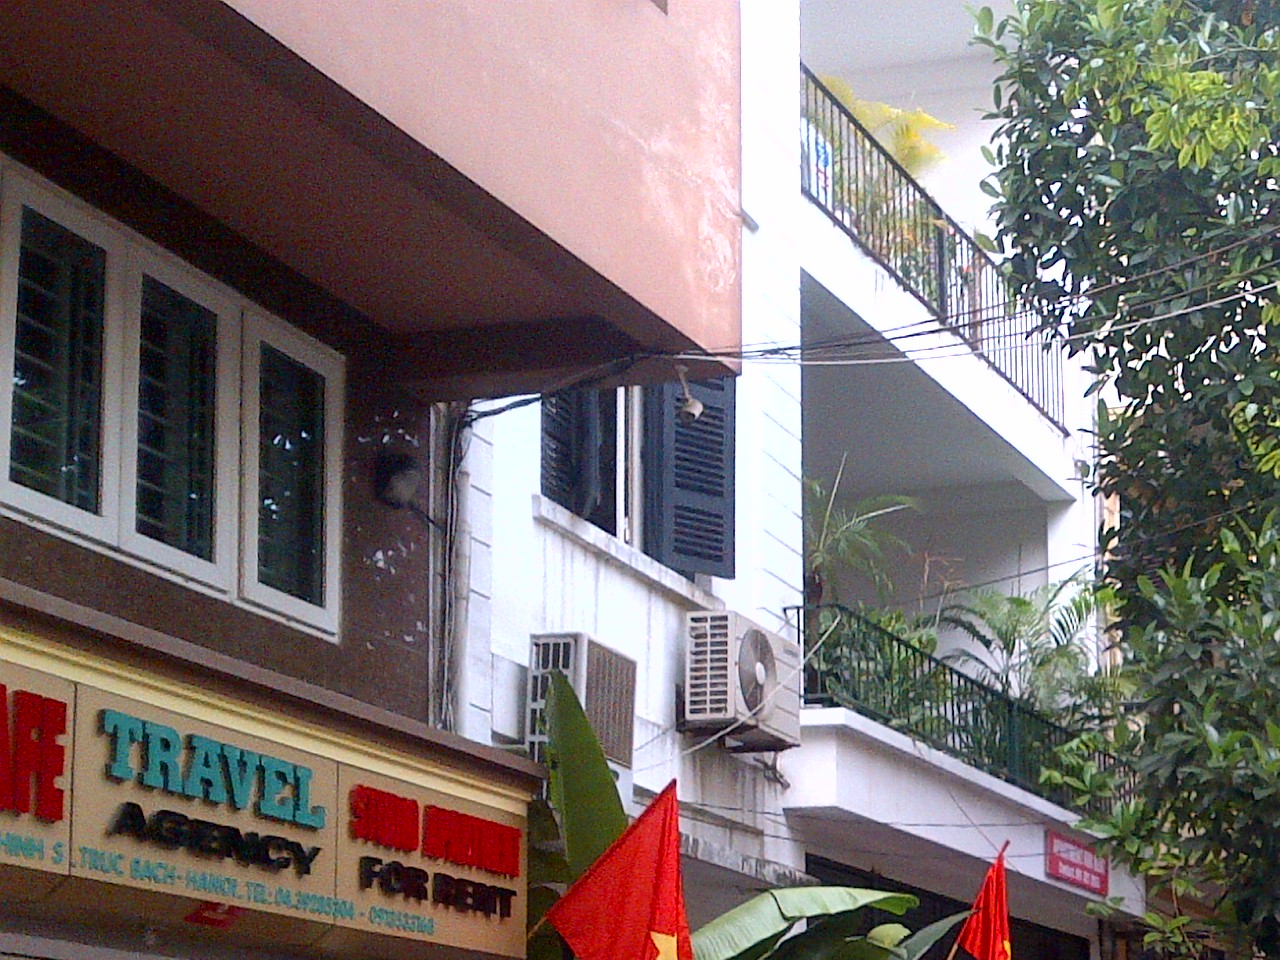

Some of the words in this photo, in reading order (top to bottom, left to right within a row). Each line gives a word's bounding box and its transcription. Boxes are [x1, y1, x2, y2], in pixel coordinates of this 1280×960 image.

[99, 708, 326, 830] TRAVEL
[106, 801, 321, 877] AGENCY
[360, 856, 429, 902] FOR
[433, 872, 517, 919] RENT
